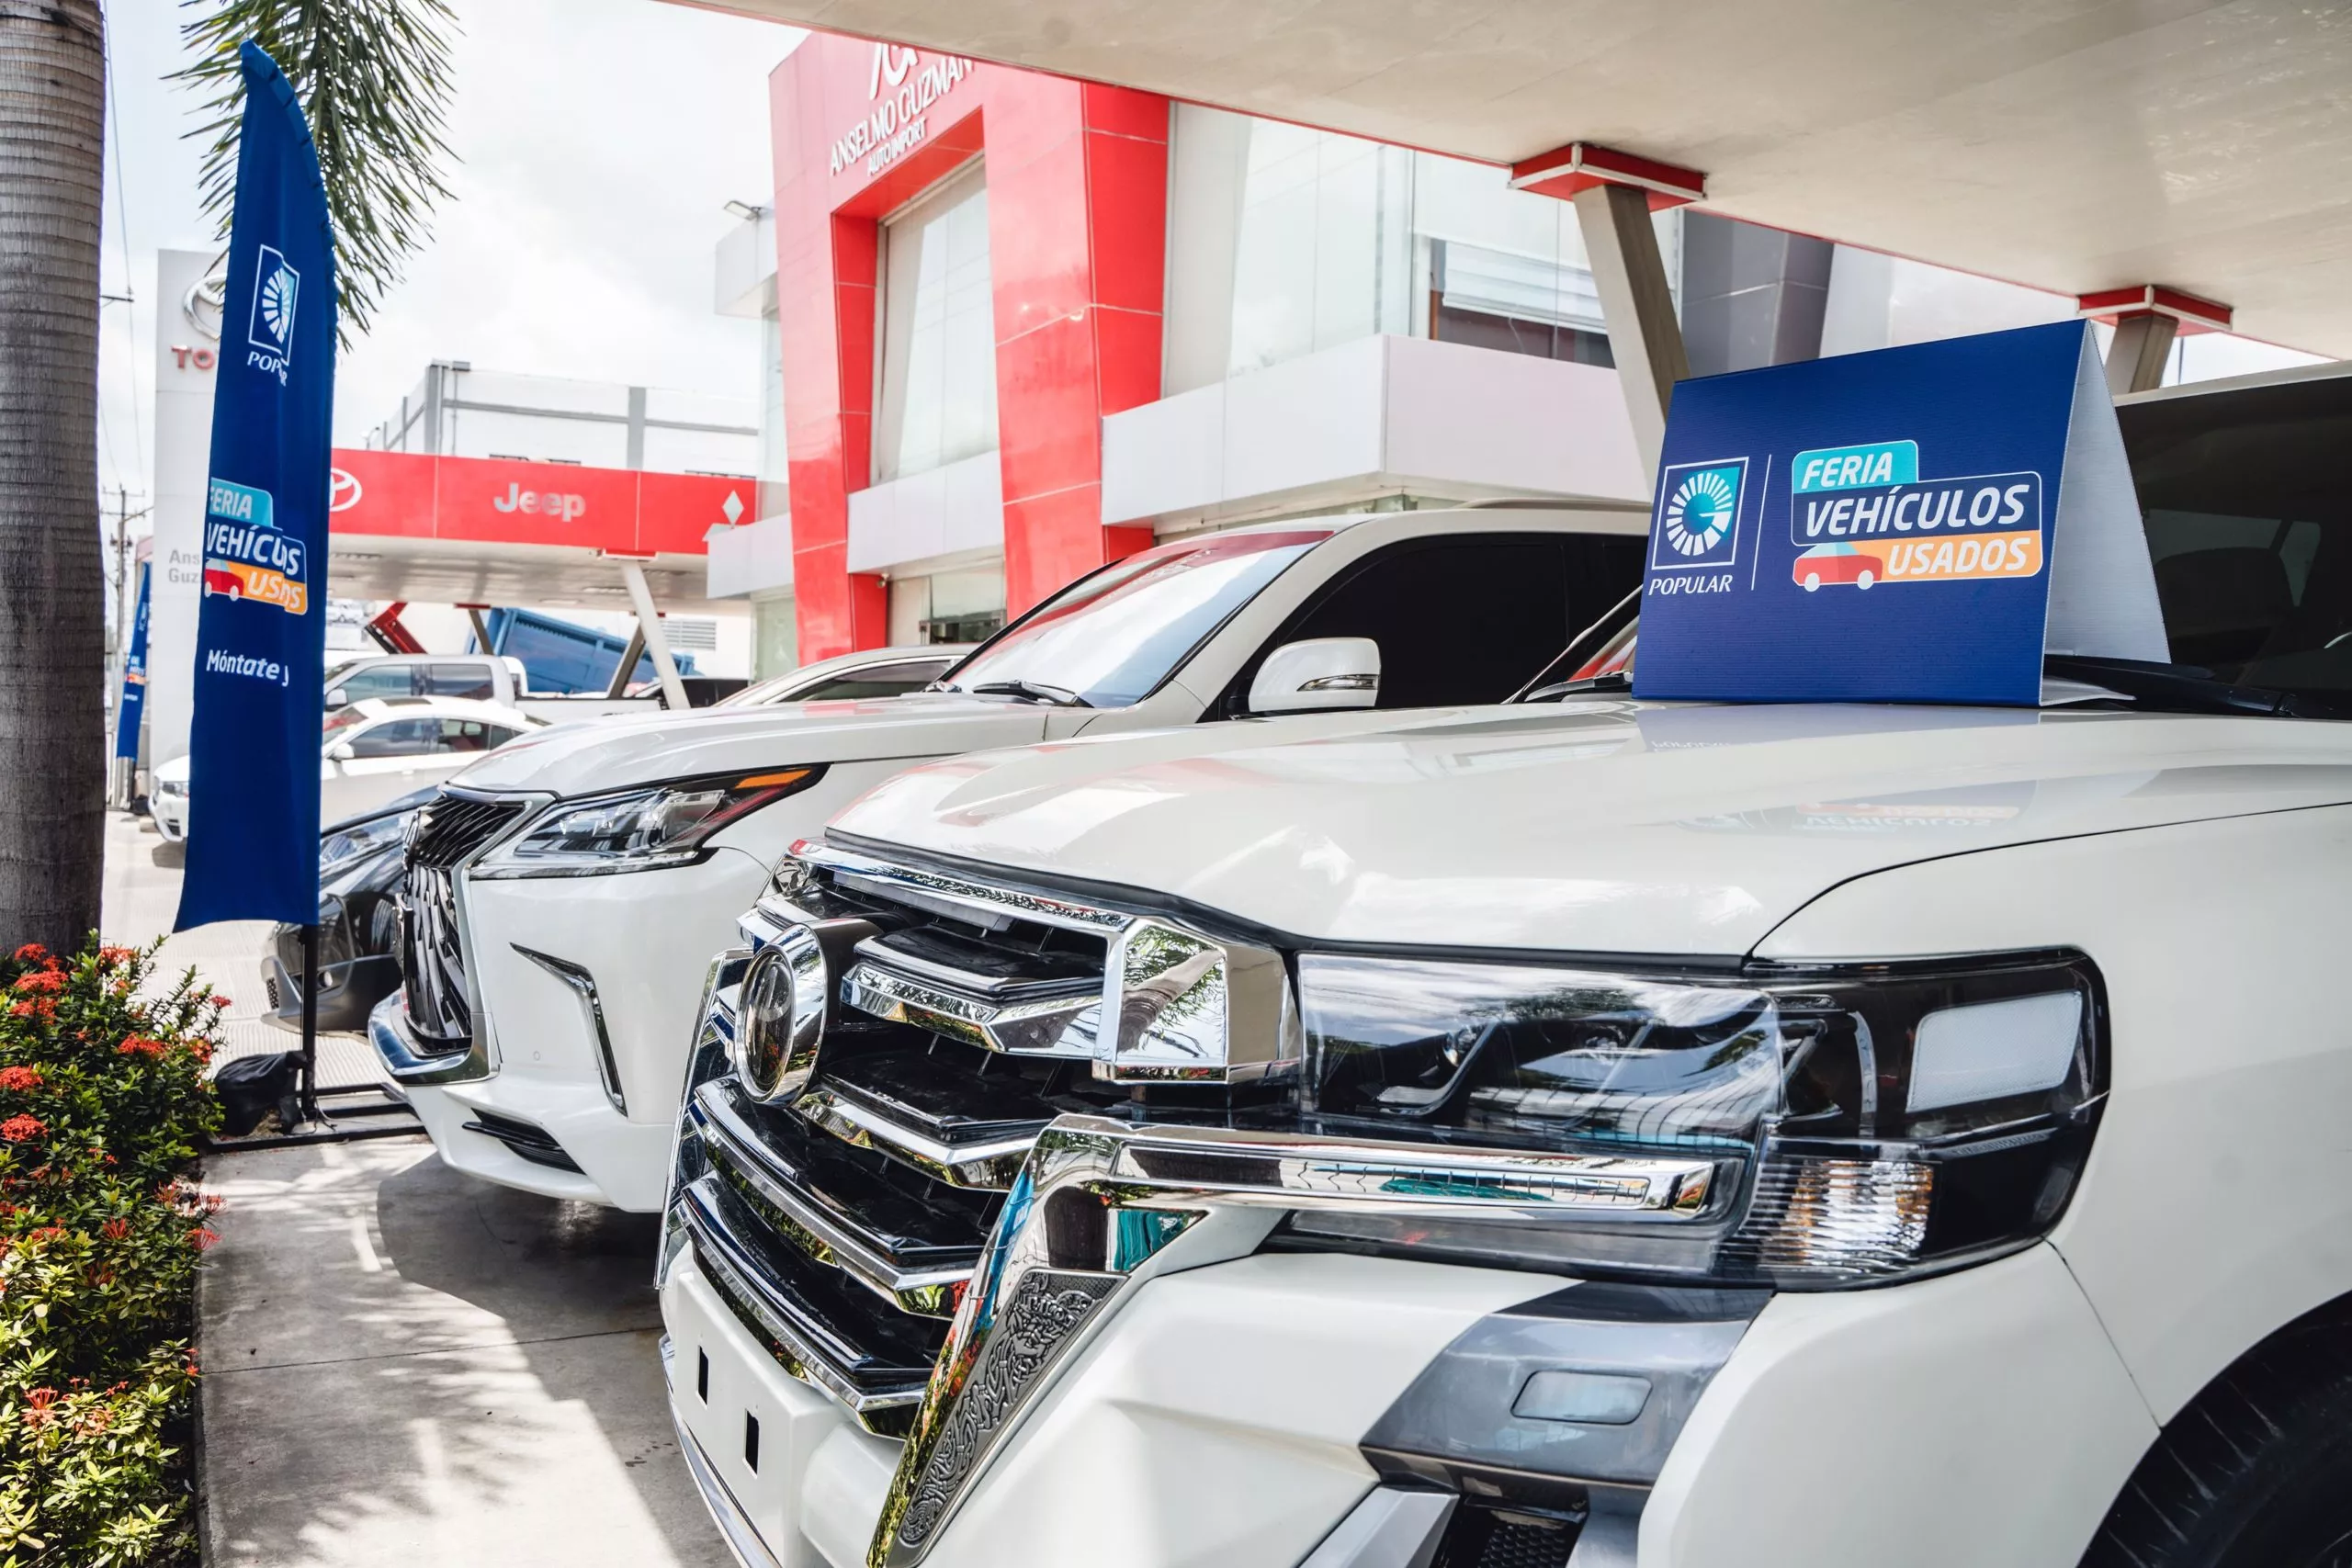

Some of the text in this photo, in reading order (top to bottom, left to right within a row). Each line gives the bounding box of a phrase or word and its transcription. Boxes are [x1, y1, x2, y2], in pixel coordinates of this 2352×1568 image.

[831, 99, 897, 176] ANSELMO
[1801, 451, 1893, 490] FERIA
[493, 482, 586, 523] Jeep
[1805, 484, 2030, 537] VEHÍCULOS
[1888, 537, 2030, 575] USADOS
[1648, 574, 1733, 596] POPULAR
[206, 649, 280, 680] Móntate
